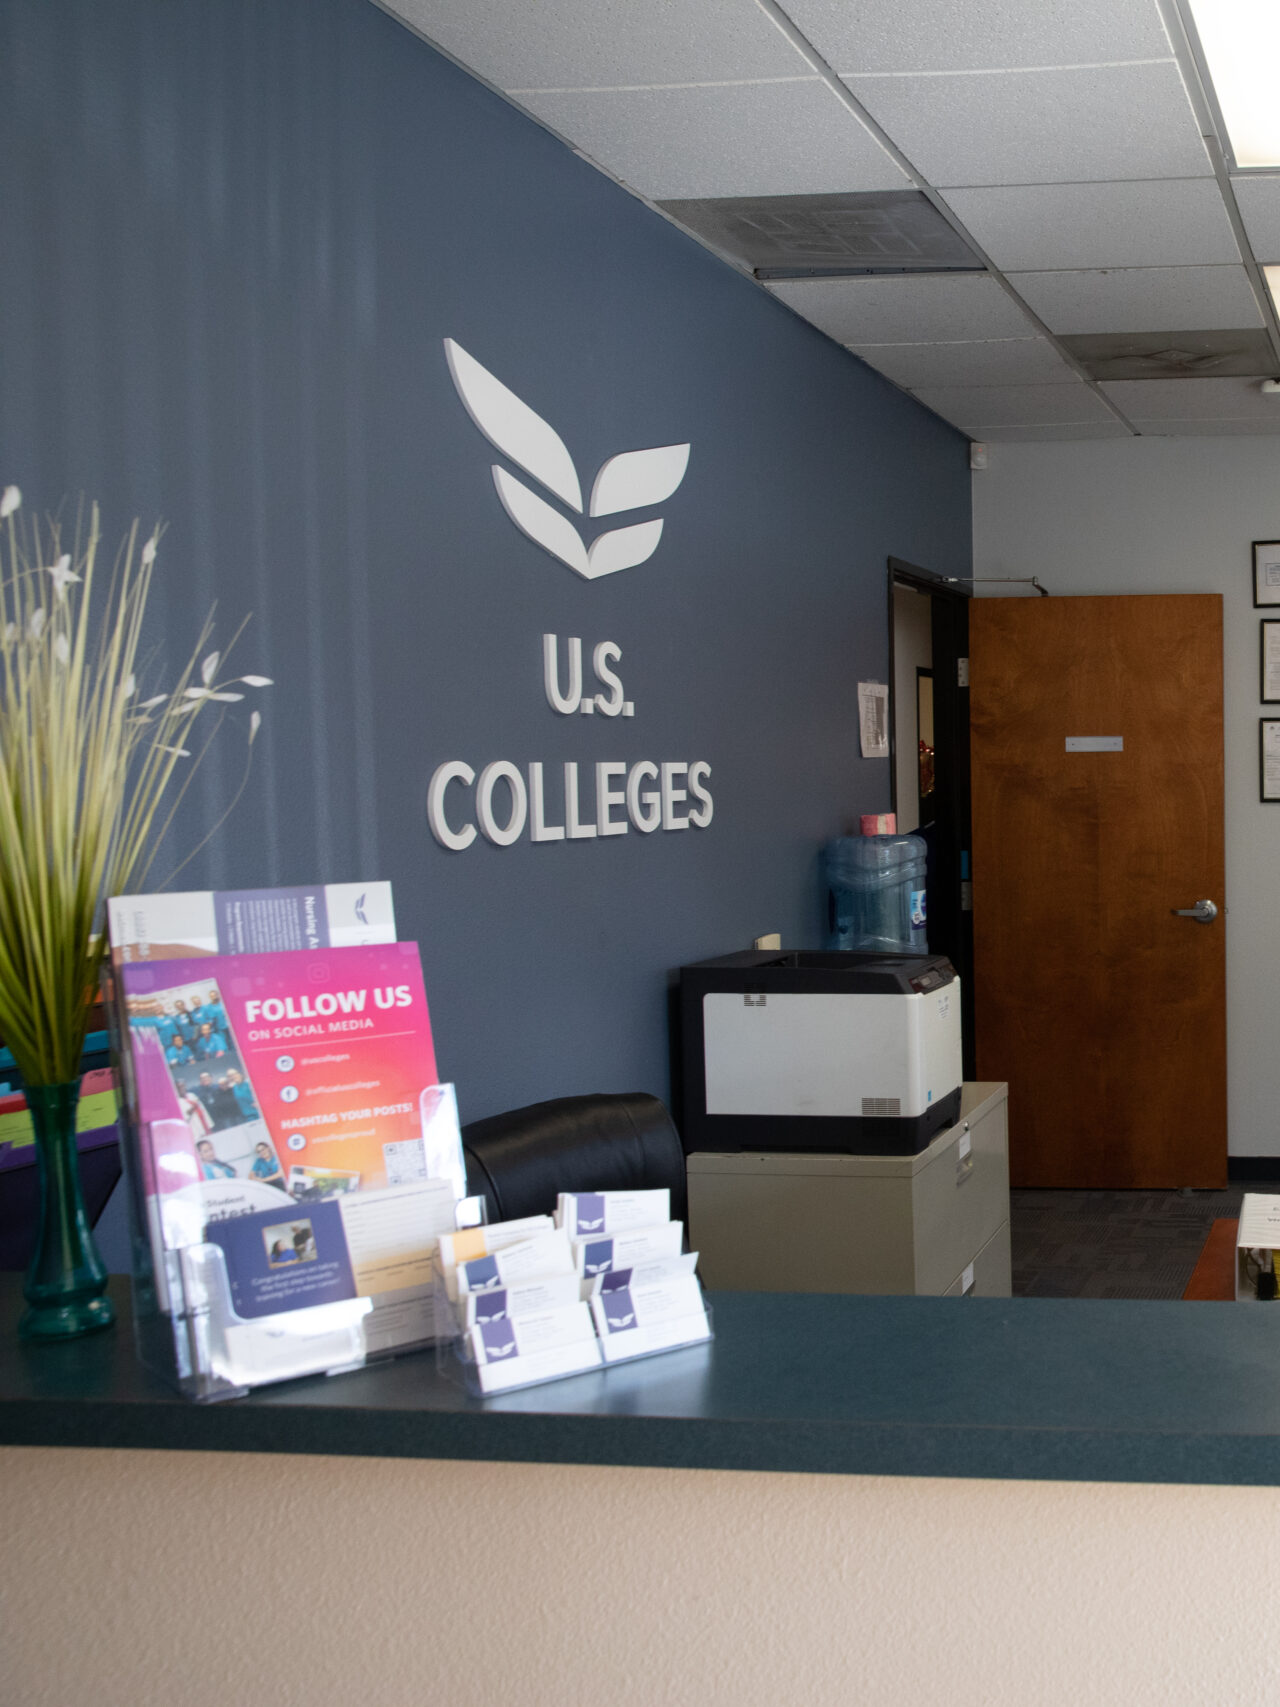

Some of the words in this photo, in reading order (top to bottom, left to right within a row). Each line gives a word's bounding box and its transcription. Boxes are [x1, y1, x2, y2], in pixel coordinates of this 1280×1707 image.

[543, 633, 635, 717] U.S.
[428, 760, 714, 851] COLLEGES
[304, 896, 317, 939] Nursing
[245, 989, 367, 1023] FOLLOW
[373, 985, 413, 1009] US
[248, 1029, 271, 1041] ON
[273, 1023, 325, 1039] SOCIAL
[327, 1017, 375, 1035] MEDIA
[280, 1112, 338, 1130] HASHTAG
[340, 1108, 372, 1122] YOUR
[373, 1102, 414, 1118] POSTS!
[209, 1204, 257, 1223] ntest
